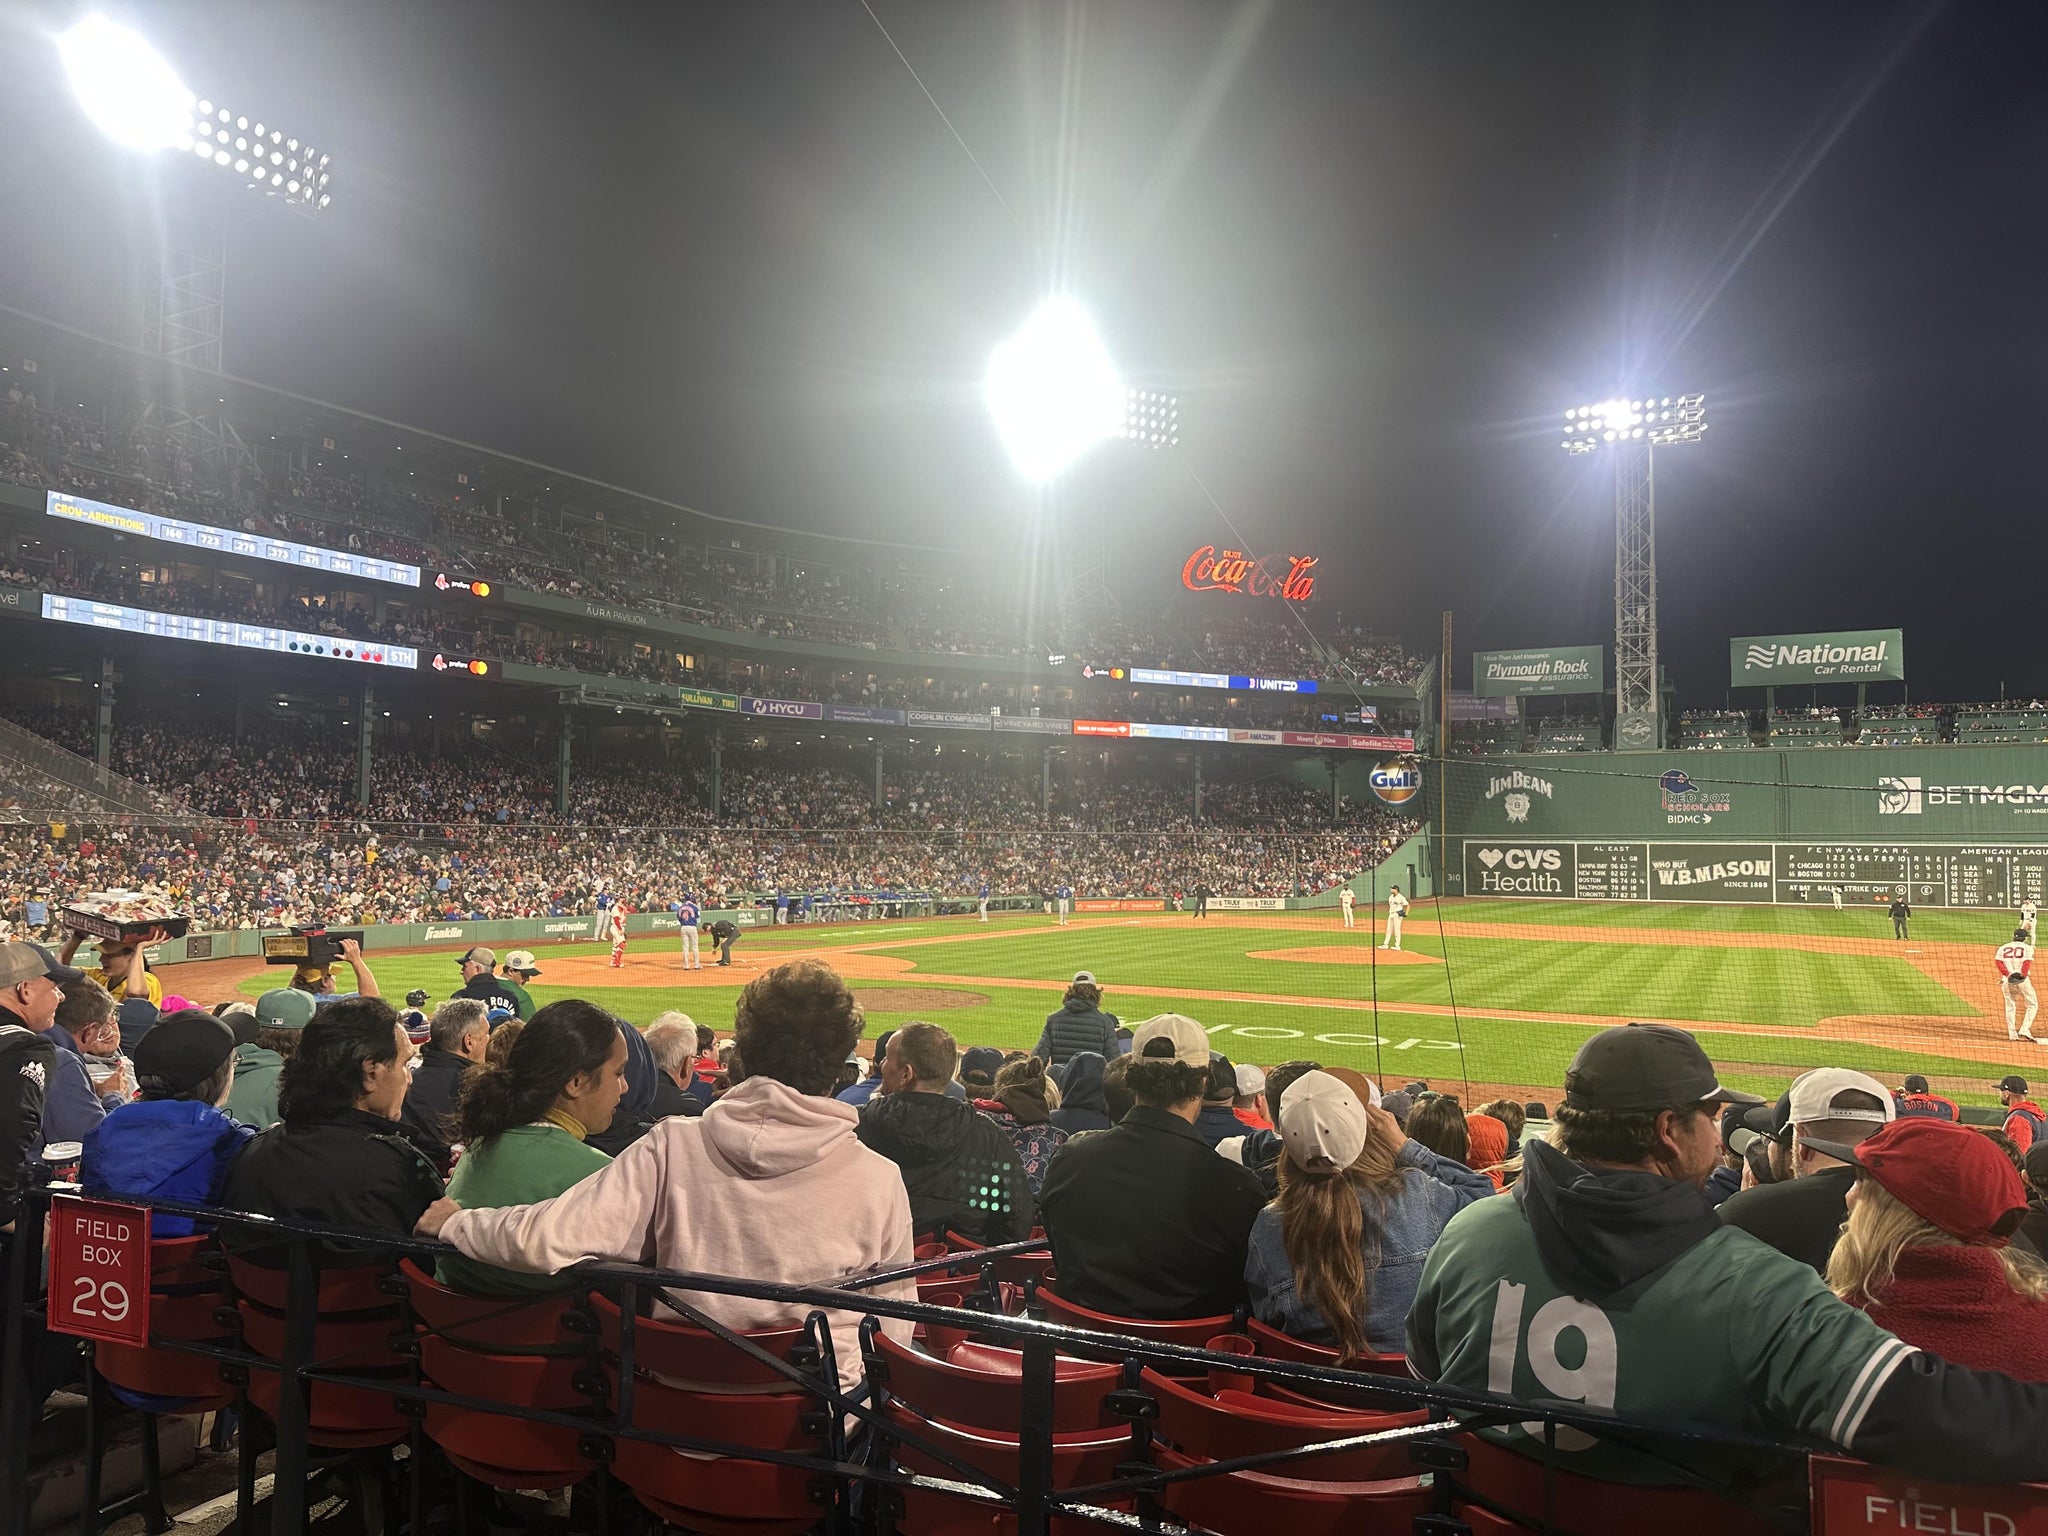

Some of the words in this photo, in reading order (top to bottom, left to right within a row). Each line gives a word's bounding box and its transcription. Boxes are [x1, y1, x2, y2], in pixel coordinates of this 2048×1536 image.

[54, 503, 145, 532] CROW-ARMSTRONG
[165, 528, 182, 539] 160
[202, 535, 220, 546] 723
[613, 611, 646, 625] PAVILION
[242, 631, 263, 642] MVR
[330, 639, 357, 649] STRIKE
[364, 643, 380, 652] OUT
[391, 651, 411, 663] 5TH
[1487, 661, 1550, 678] Plymouth
[1554, 659, 1589, 673] Rock
[1814, 666, 1836, 675] Car
[1840, 663, 1881, 673] Rental
[1260, 680, 1298, 691] UNITED
[682, 692, 712, 705] SULLIVAN
[722, 699, 735, 708] TIRE
[770, 703, 804, 715] HYCU
[910, 713, 944, 722] COGHLIN
[945, 714, 990, 723] COMPANIES
[1352, 739, 1382, 748] Safelite
[1372, 772, 1418, 787] Gulf
[1485, 776, 1512, 799] JIM
[1513, 771, 1554, 799] BEAM
[1668, 793, 1696, 802] RED
[1700, 793, 1730, 802] SOX
[1928, 786, 2048, 804] BETMGM
[1668, 803, 1730, 812] SCHOLARS
[1668, 815, 1700, 823] BIDMC
[1505, 849, 1561, 870] CVS
[1481, 871, 1562, 892] Health
[1801, 891, 1807, 901] 4
[682, 911, 689, 920] 4
[424, 926, 463, 941] Franklin
[545, 922, 589, 932] smartwater
[2003, 947, 2024, 958] 20
[1904, 1101, 1939, 1112] BOSTON
[75, 1218, 130, 1242] FIELD
[82, 1245, 122, 1267] BOX
[72, 1276, 130, 1321] 29
[1488, 1278, 1618, 1452] 19
[1866, 1495, 2016, 1536] FIELD
